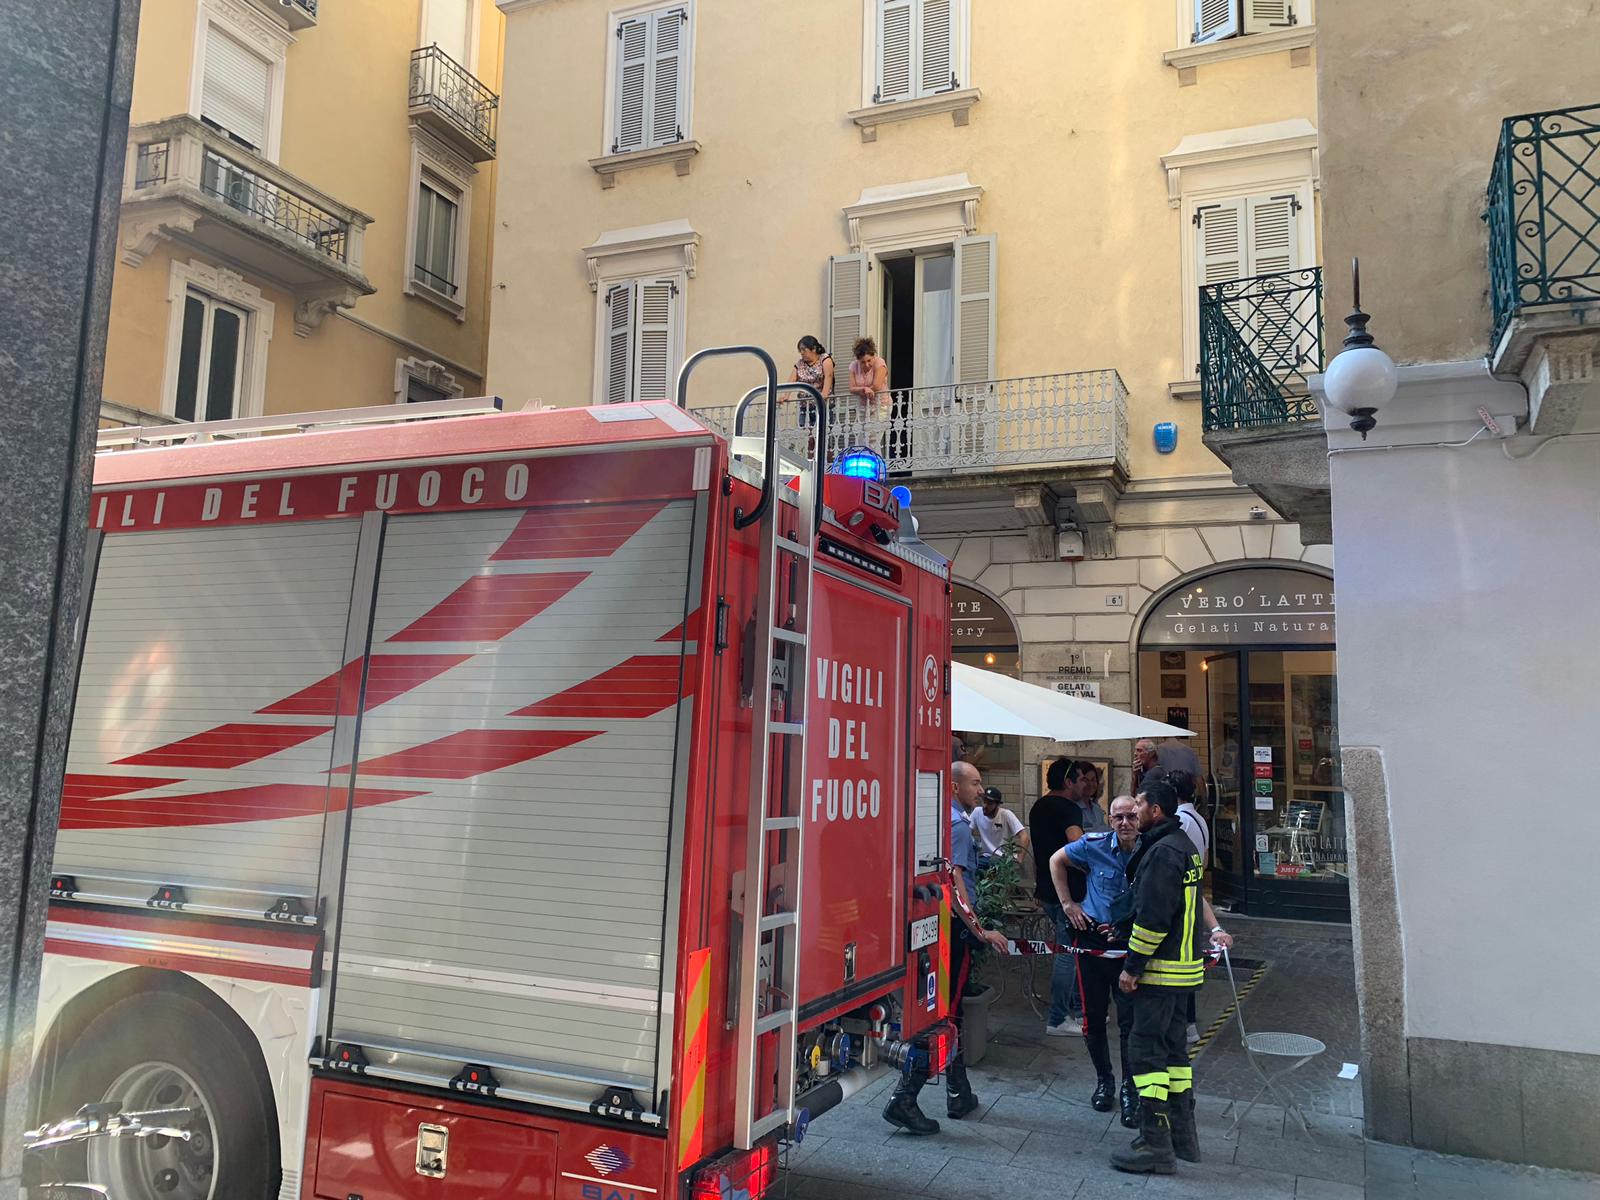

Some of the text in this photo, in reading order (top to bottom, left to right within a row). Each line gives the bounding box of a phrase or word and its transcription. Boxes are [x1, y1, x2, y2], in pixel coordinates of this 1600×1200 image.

[95, 463, 530, 528] ILI DEL FUOCO
[950, 601, 981, 613] TE
[950, 627, 985, 638] ery
[1174, 621, 1336, 634] Gelati Natura
[771, 665, 786, 679] AI
[1058, 665, 1092, 674] PREMIO
[816, 657, 883, 708] VIGILI
[918, 705, 941, 728] 115
[827, 717, 869, 760] DEL
[811, 779, 881, 822] FUOCO
